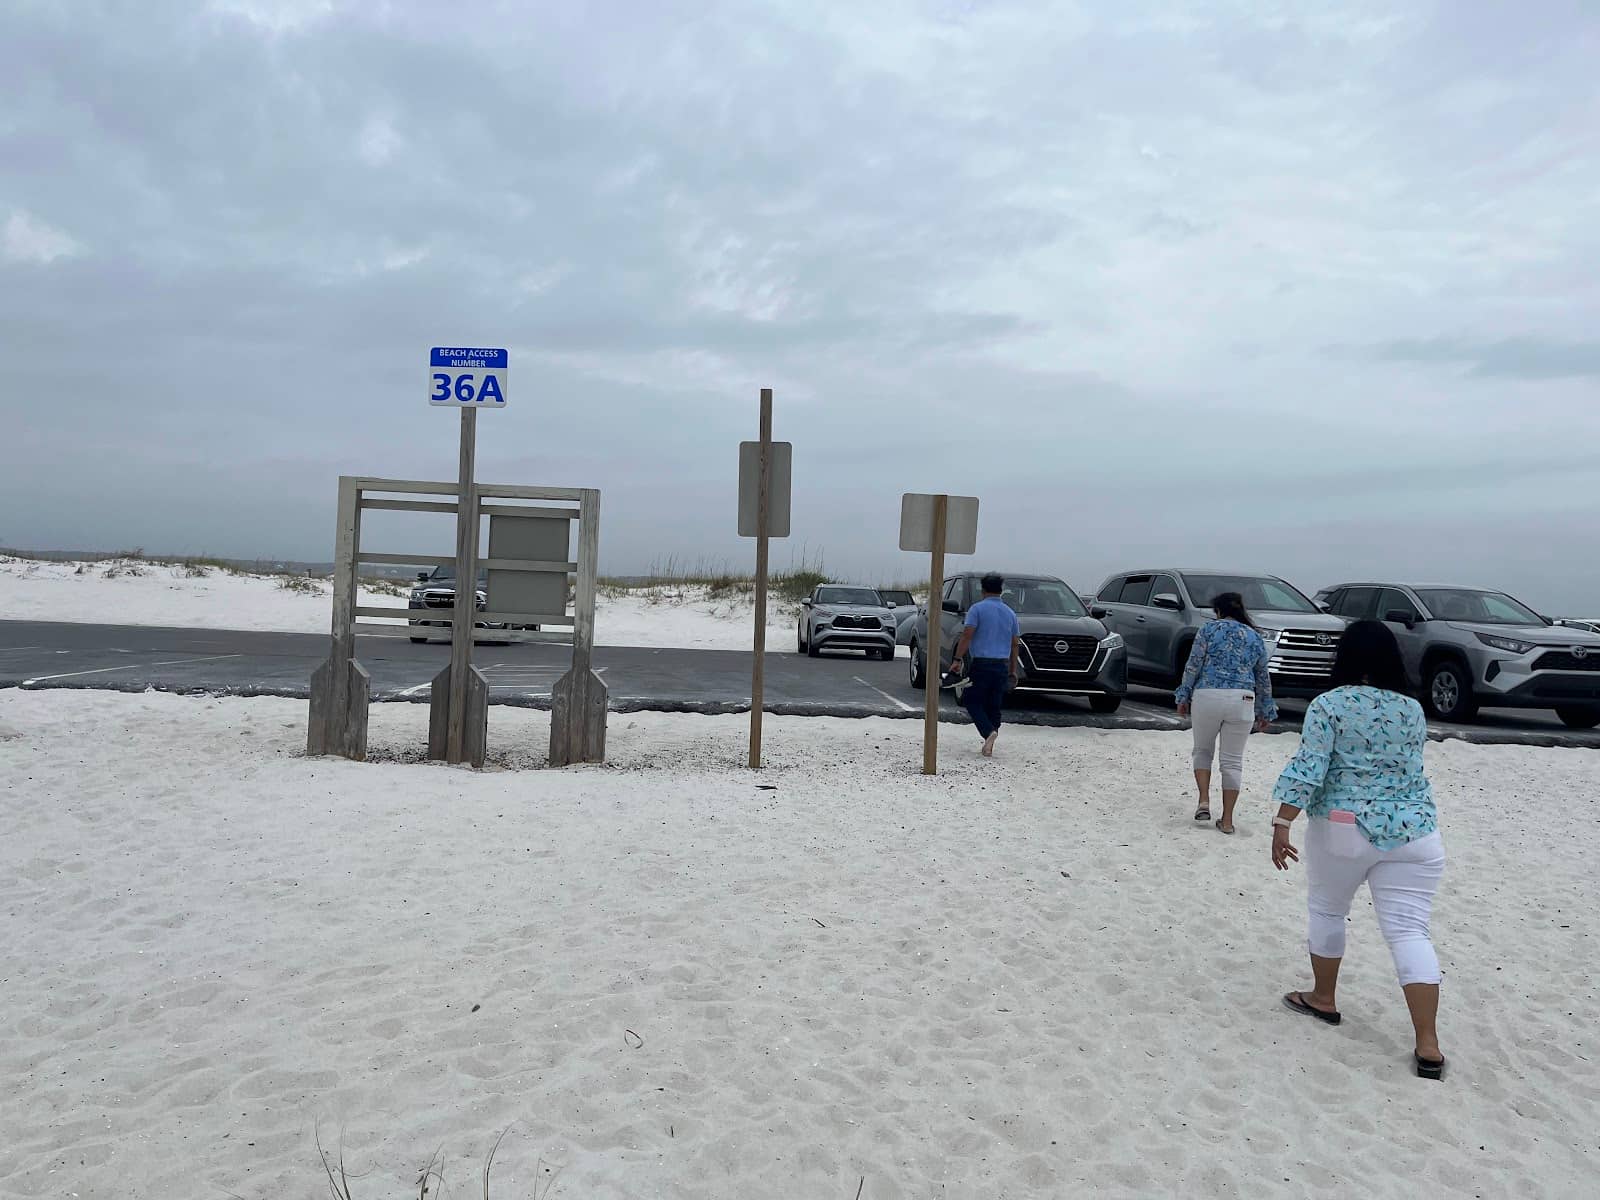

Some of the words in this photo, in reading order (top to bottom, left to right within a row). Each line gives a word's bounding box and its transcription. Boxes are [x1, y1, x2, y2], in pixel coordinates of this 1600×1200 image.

[439, 349, 466, 357] BEACH
[468, 350, 499, 358] ACCESS
[451, 359, 486, 367] NUMBER
[431, 373, 505, 403] 36A
